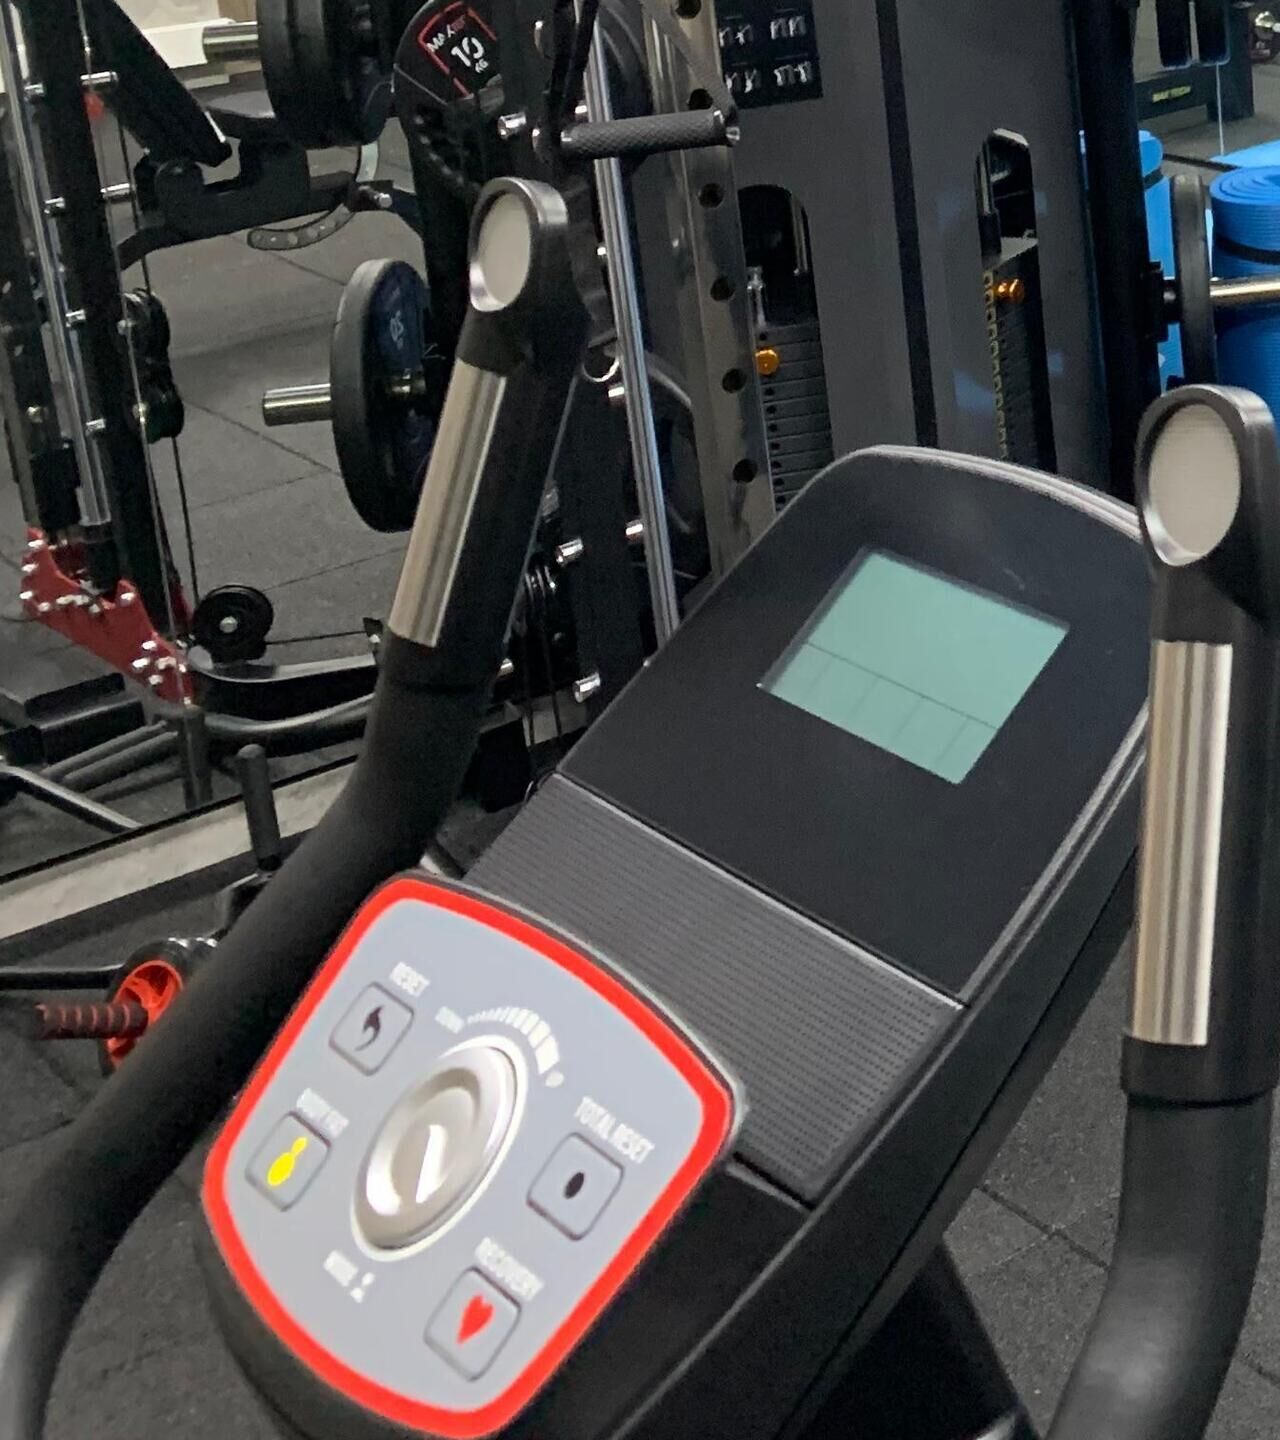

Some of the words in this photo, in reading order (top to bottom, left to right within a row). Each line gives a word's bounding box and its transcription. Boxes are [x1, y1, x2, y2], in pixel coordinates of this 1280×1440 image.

[451, 37, 484, 67] 10
[390, 962, 430, 997] RESET
[574, 1096, 617, 1140] TOTAL
[611, 1123, 655, 1164] RESET
